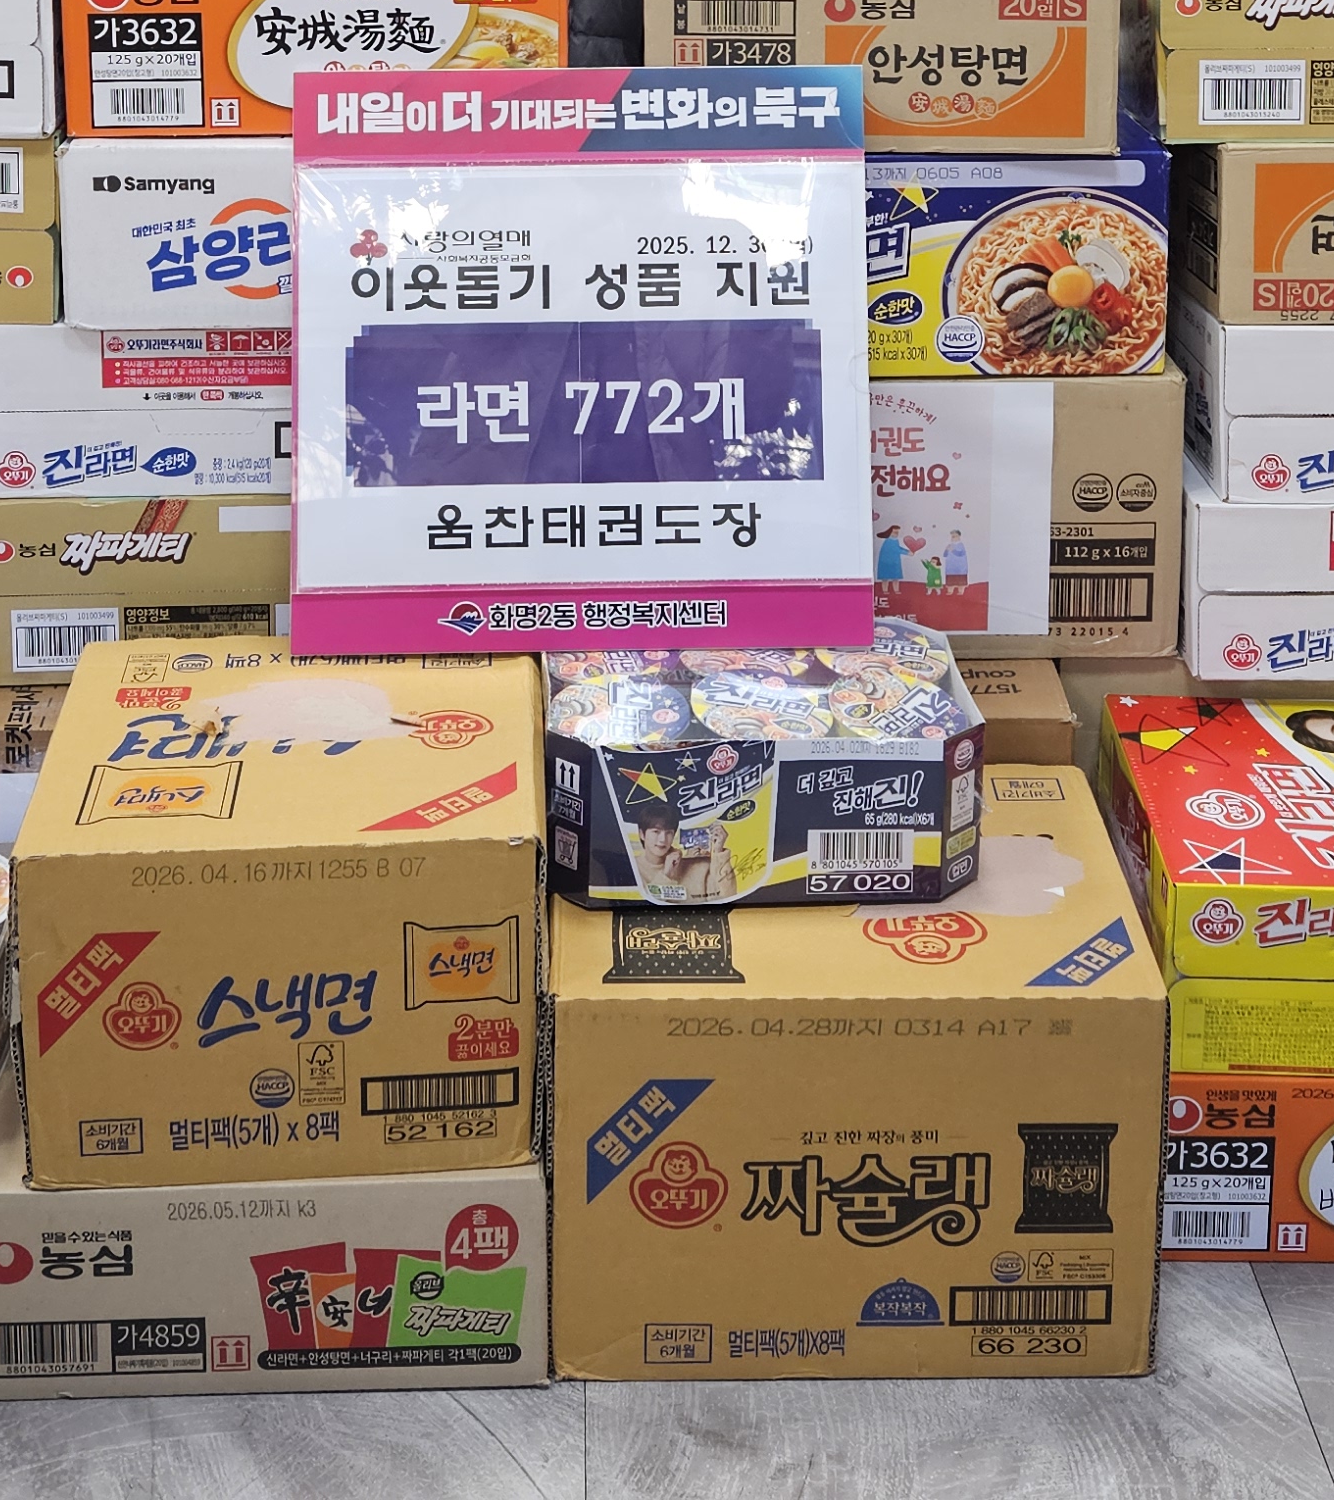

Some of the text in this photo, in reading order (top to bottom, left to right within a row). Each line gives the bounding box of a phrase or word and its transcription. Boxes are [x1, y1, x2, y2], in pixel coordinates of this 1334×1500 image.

[93, 17, 198, 48] 가3632
[867, 42, 1030, 87] 안성탕면
[315, 85, 842, 134] 내일이 더 기대되는 변화의 북구
[124, 174, 216, 195] Samyang
[916, 167, 1004, 181] 0605 A08
[131, 218, 196, 238] 대한민국 최초
[636, 234, 738, 256] 2025. 12.
[350, 260, 811, 313] 이웃돕기 성품 지원
[415, 375, 747, 445] 라면 772개
[426, 501, 763, 551] 움찬태권도장
[488, 599, 729, 631] 화명2동 행정복지센터
[677, 762, 765, 816] 진라면
[817, 765, 855, 791] 깊고
[318, 859, 368, 881] 1255
[399, 856, 427, 878] 07
[809, 872, 912, 893] 57 020
[43, 938, 125, 1020] 멀티팩
[197, 970, 379, 1050] 스낵면
[454, 1013, 517, 1041] 2분만
[666, 1017, 1033, 1037] 2026.04.28까지 0314 A17
[169, 1109, 341, 1150] 멀티팩(5개) 8팩
[386, 1119, 498, 1142] 52 162
[799, 1130, 828, 1145] 깊고
[833, 1130, 863, 1145] 진한
[910, 1130, 940, 1145] 풍미
[739, 1152, 992, 1248] 짜슐랭
[450, 1228, 510, 1260] 4팩
[38, 1245, 134, 1279] 농심
[116, 1321, 201, 1351] 가4859
[404, 1304, 516, 1339] 짜파게티
[977, 1336, 1083, 1356] 66 230
